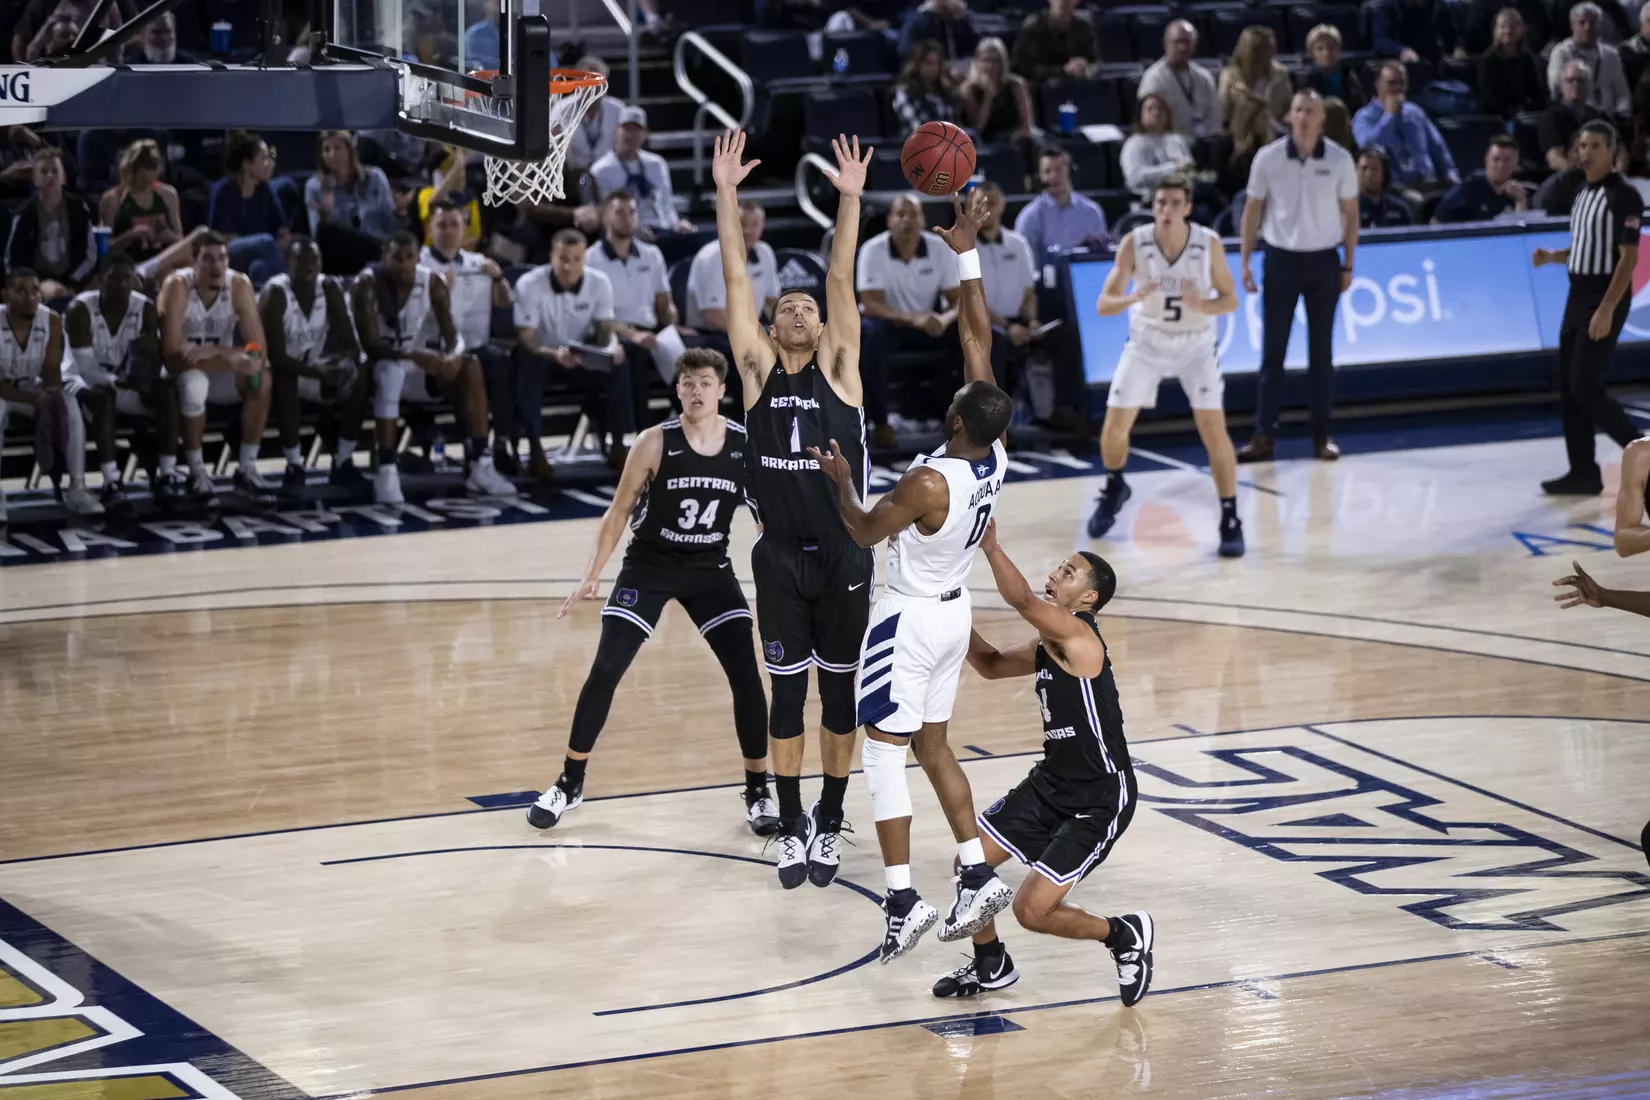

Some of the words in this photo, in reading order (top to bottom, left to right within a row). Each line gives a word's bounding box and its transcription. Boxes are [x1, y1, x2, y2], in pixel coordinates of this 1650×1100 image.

[1163, 296, 1182, 322] 5
[790, 416, 802, 454] 1
[761, 455, 821, 471] ARKANS
[667, 476, 737, 494] CENTRAL
[677, 498, 720, 530] 34
[964, 503, 992, 550] 0
[660, 527, 724, 544] ARKANSAS
